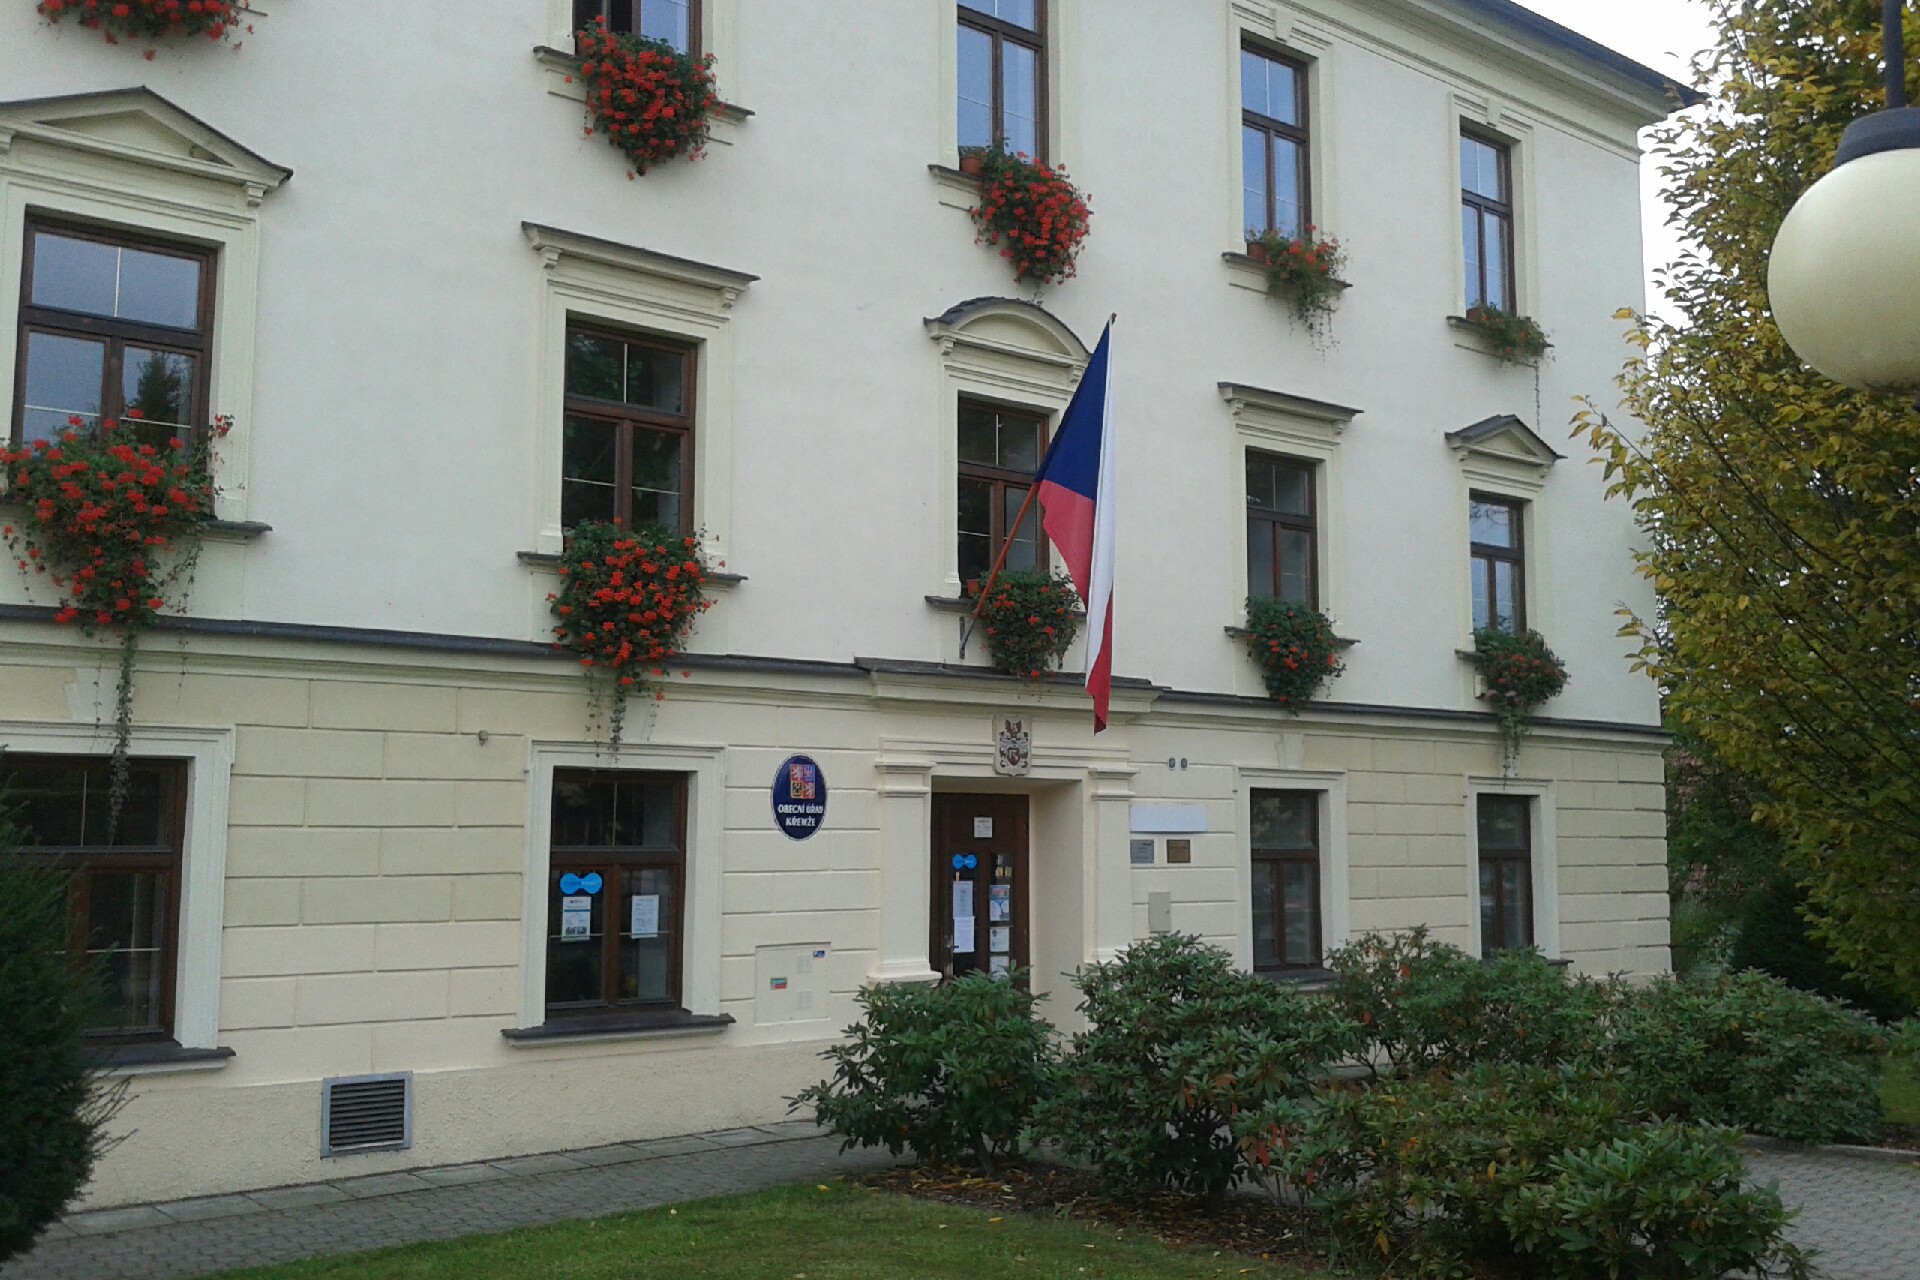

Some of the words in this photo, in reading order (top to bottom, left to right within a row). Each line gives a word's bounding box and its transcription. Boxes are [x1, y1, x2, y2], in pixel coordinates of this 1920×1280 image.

[778, 803, 805, 813] OBECNÍ
[806, 803, 823, 813] ÚŘAD
[786, 816, 815, 826] KŘEMŽE
